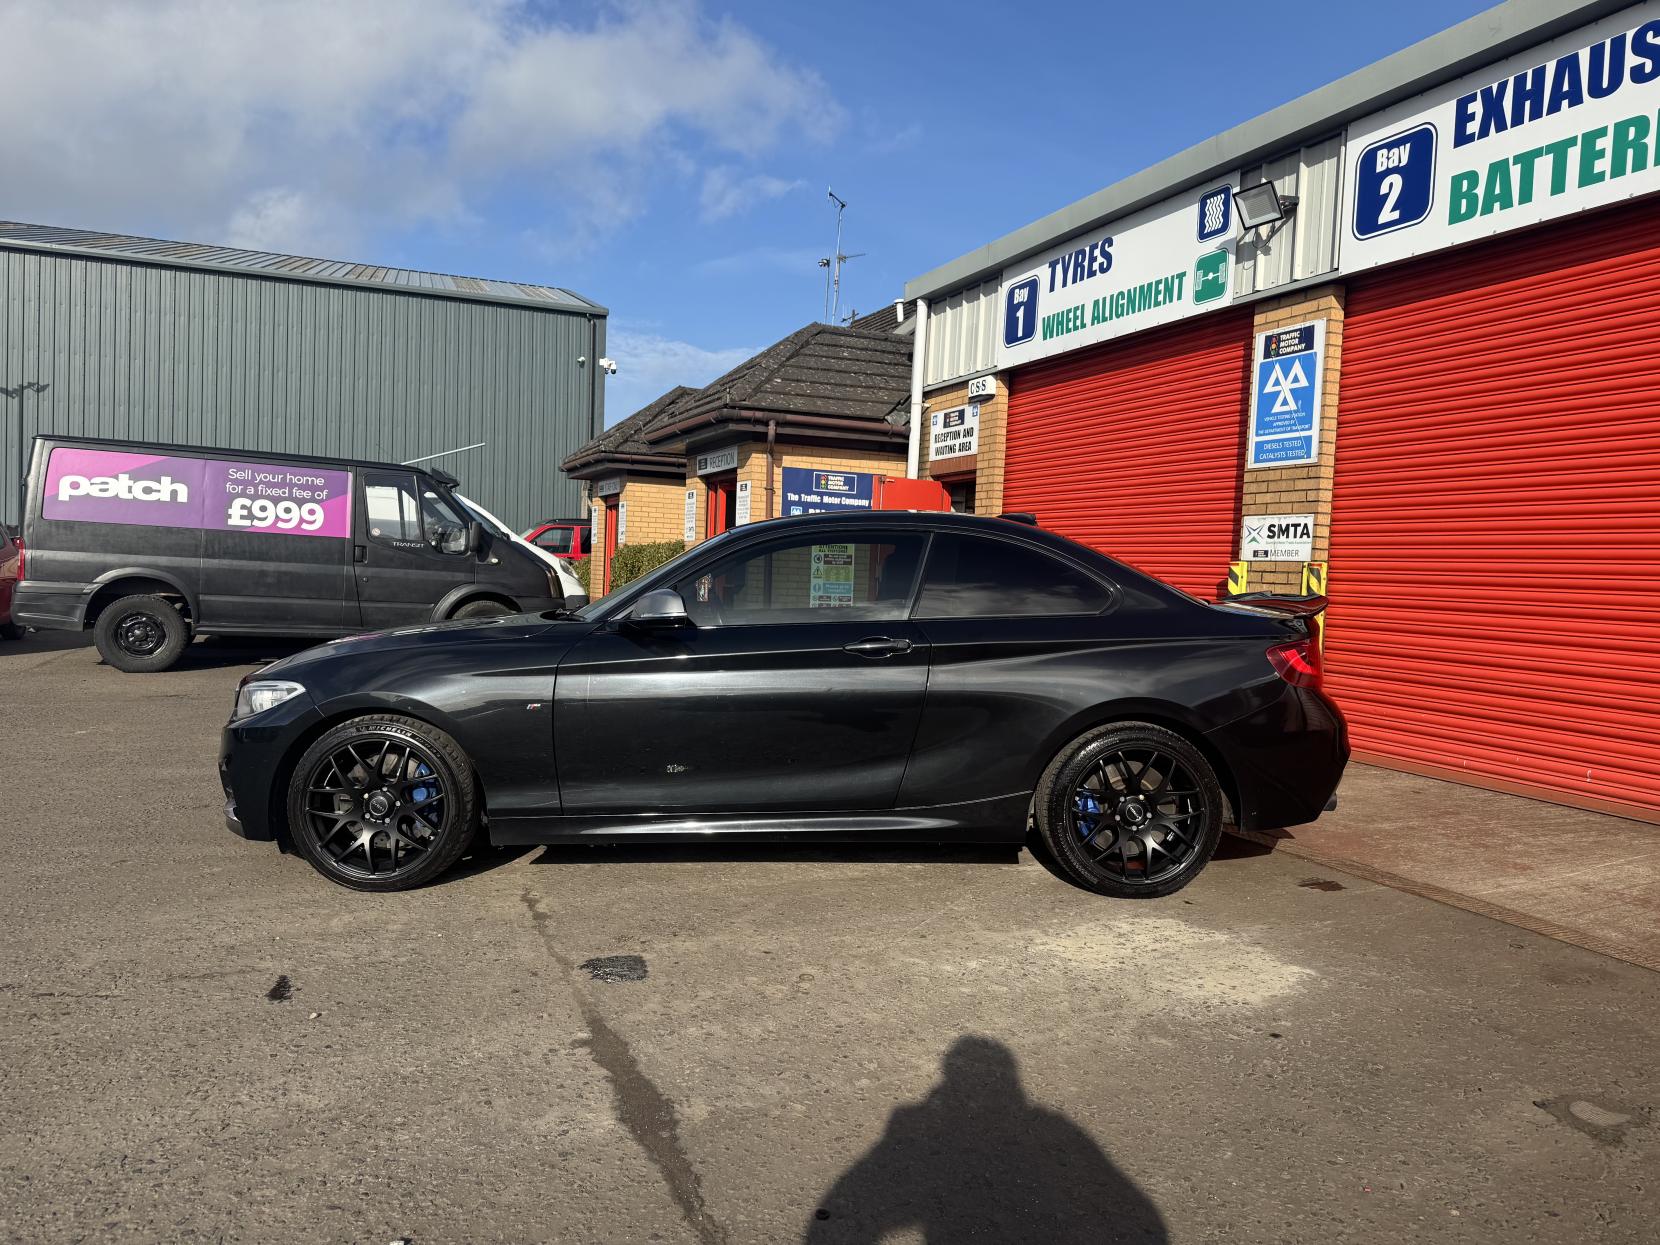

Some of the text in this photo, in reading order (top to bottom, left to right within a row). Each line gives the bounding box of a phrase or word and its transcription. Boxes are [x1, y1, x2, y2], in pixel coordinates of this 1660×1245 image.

[1375, 140, 1411, 174] Bay
[1377, 173, 1403, 225] 2
[1048, 237, 1113, 293] TYRES
[1013, 285, 1030, 304] Bay
[1042, 270, 1187, 341] WHEEL ALIGNMENT
[1016, 305, 1025, 337] 1
[1280, 331, 1300, 341] TRAFFIC
[1280, 339, 1299, 348] MOTOR
[1279, 343, 1306, 354] COMPANY
[934, 427, 974, 444] RECEPTION AND
[935, 441, 972, 457] WAITING AREA
[1264, 440, 1302, 450] DIESELS TESTED
[709, 452, 735, 469] RECEPTION
[1260, 449, 1306, 460] CATALYSTS TESTED
[228, 468, 325, 486] Sell your home
[58, 473, 188, 503] patch
[226, 482, 329, 500] for a fixed fee of
[787, 492, 799, 501] The
[801, 494, 821, 503] Traffic
[823, 495, 841, 504] Motor
[841, 497, 869, 507] Company
[227, 497, 325, 531] £999
[1266, 523, 1311, 539] SMTA
[392, 541, 425, 549] TRANSIT
[1270, 549, 1300, 558] MEMBER
[368, 725, 412, 737] MICHELIN
